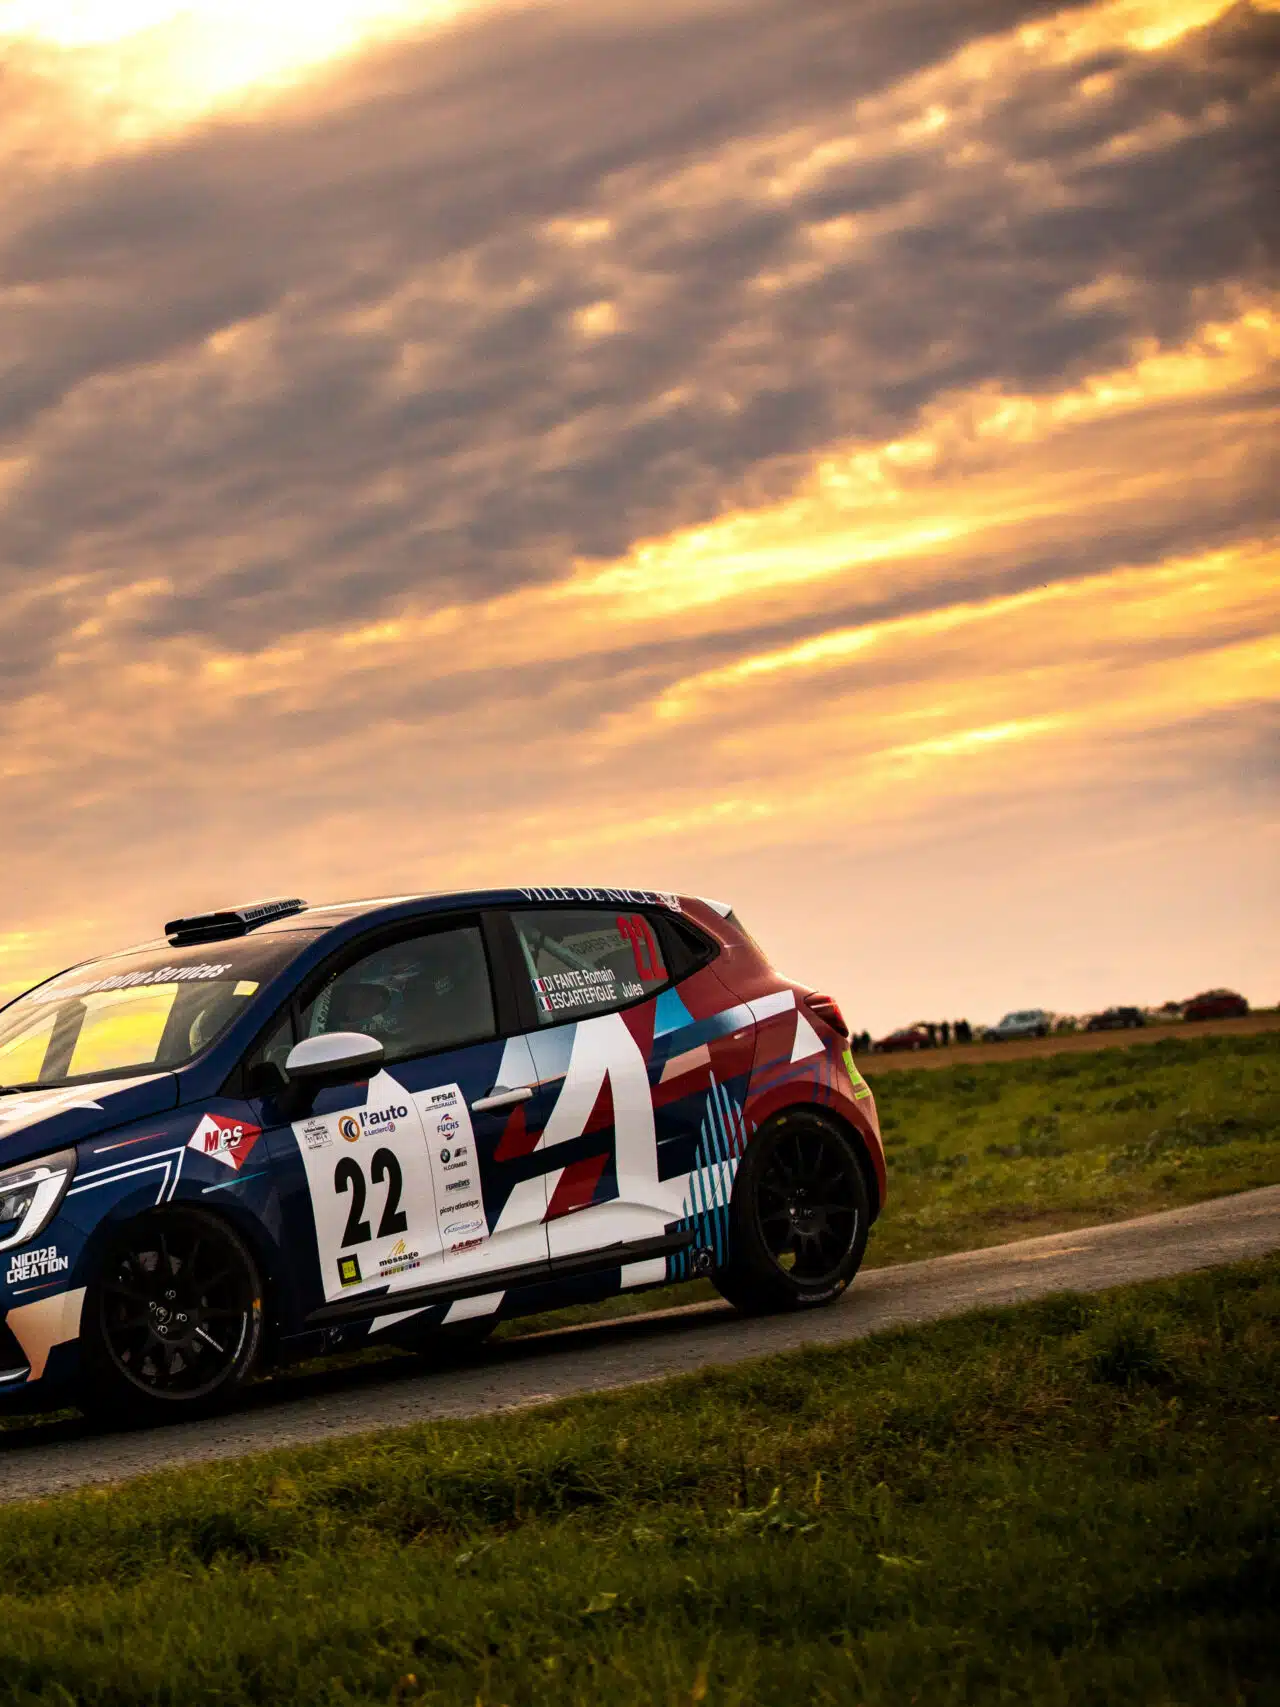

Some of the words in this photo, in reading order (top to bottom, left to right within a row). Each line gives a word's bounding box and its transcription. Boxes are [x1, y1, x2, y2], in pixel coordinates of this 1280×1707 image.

[518, 887, 573, 901] VILLE
[575, 888, 605, 901] DE
[605, 889, 657, 904] NICE
[616, 912, 669, 982] 22
[145, 963, 233, 984] Services
[543, 975, 554, 992] DI
[556, 969, 585, 989] FANTE
[582, 966, 616, 984] Romain
[551, 984, 617, 1009] ESCARTEFIGUE
[622, 981, 645, 998] Jules
[359, 1105, 408, 1128] l'auto
[437, 1121, 460, 1133] FUCHS
[334, 1147, 408, 1248] 22
[6, 1256, 69, 1284] CREATION
[11, 1245, 57, 1270] NICO2B
[379, 1251, 419, 1267] message
